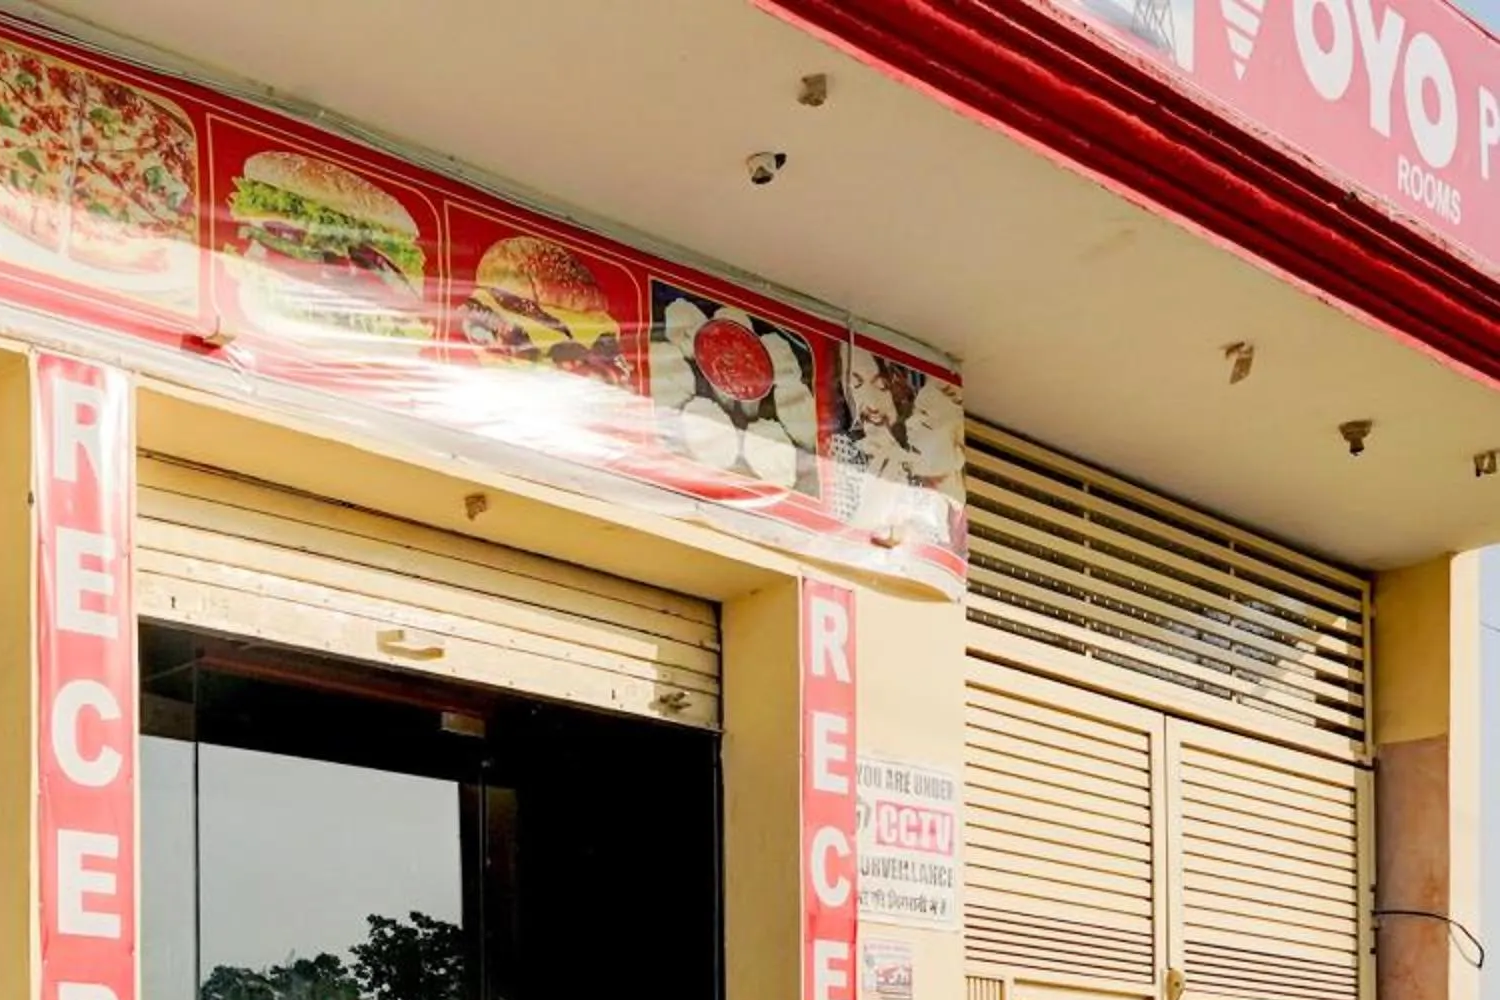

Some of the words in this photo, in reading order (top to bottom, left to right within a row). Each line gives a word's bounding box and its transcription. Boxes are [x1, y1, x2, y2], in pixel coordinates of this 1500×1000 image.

[1293, 0, 1458, 169] OYO
[1398, 153, 1462, 225] ROOMS
[885, 769, 911, 794] ARE
[878, 803, 951, 852] CCTV
[859, 856, 953, 888] URVEILLANCE
